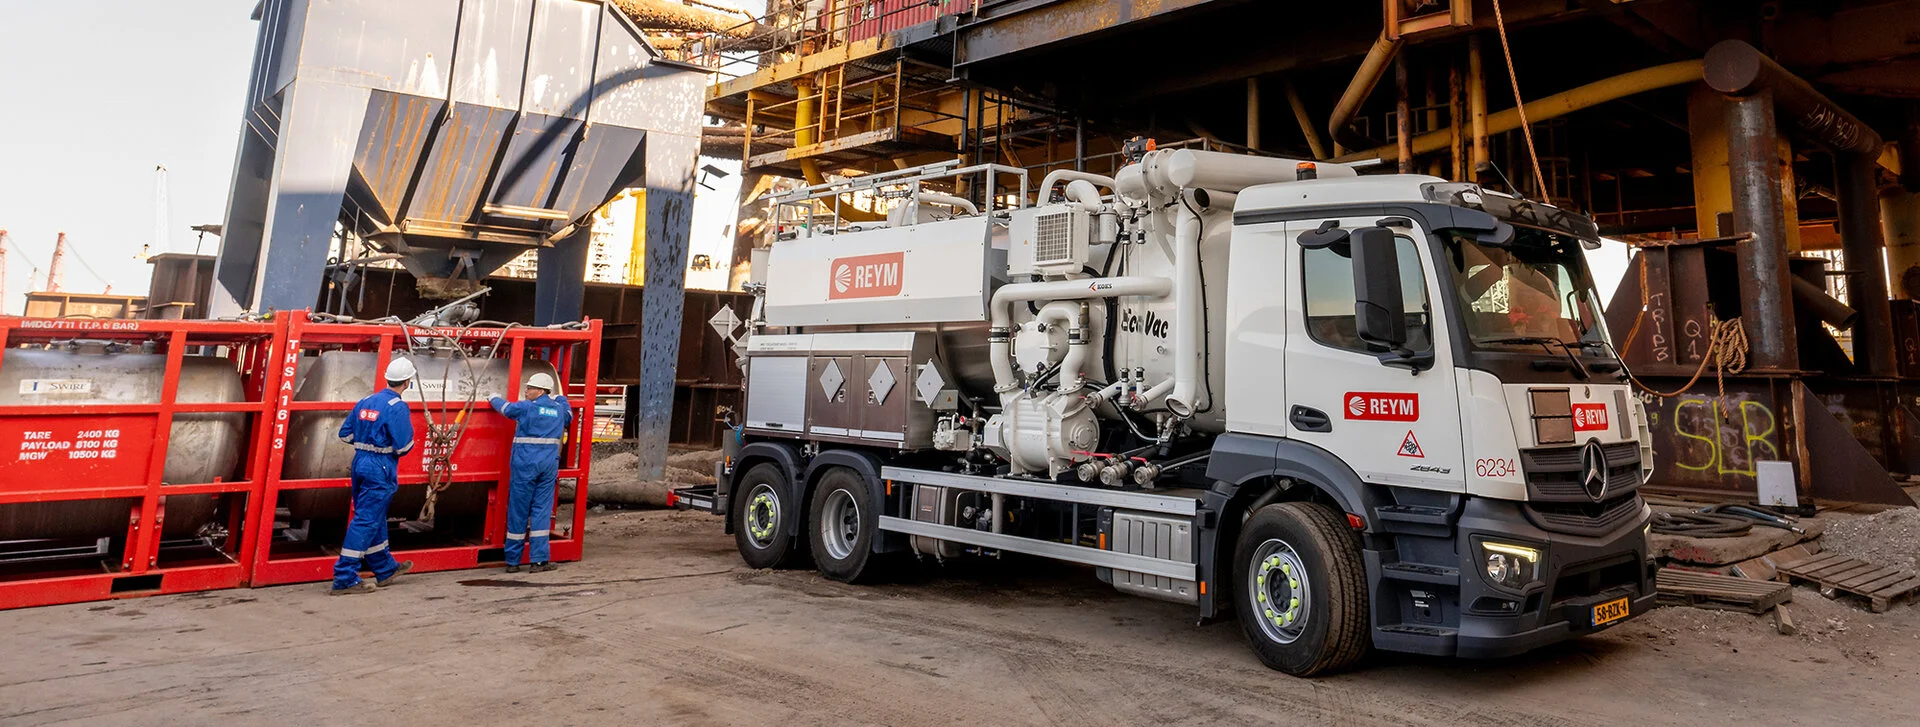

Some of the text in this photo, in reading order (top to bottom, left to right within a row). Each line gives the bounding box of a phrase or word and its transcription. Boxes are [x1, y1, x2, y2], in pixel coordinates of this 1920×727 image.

[855, 262, 898, 288] REYM
[112, 322, 139, 330] BAR)
[414, 328, 453, 336] IMDGT11
[273, 339, 298, 449] THSA1613
[1370, 398, 1414, 415] REYM
[1585, 409, 1607, 424] REYM
[23, 429, 120, 439] TARE 2400 KG
[21, 439, 118, 450] PAYLOAD 8100 KG
[19, 449, 117, 460] MGW 10500 KG
[1475, 458, 1516, 477] 6234
[1596, 600, 1627, 622] 58-BZK-4
